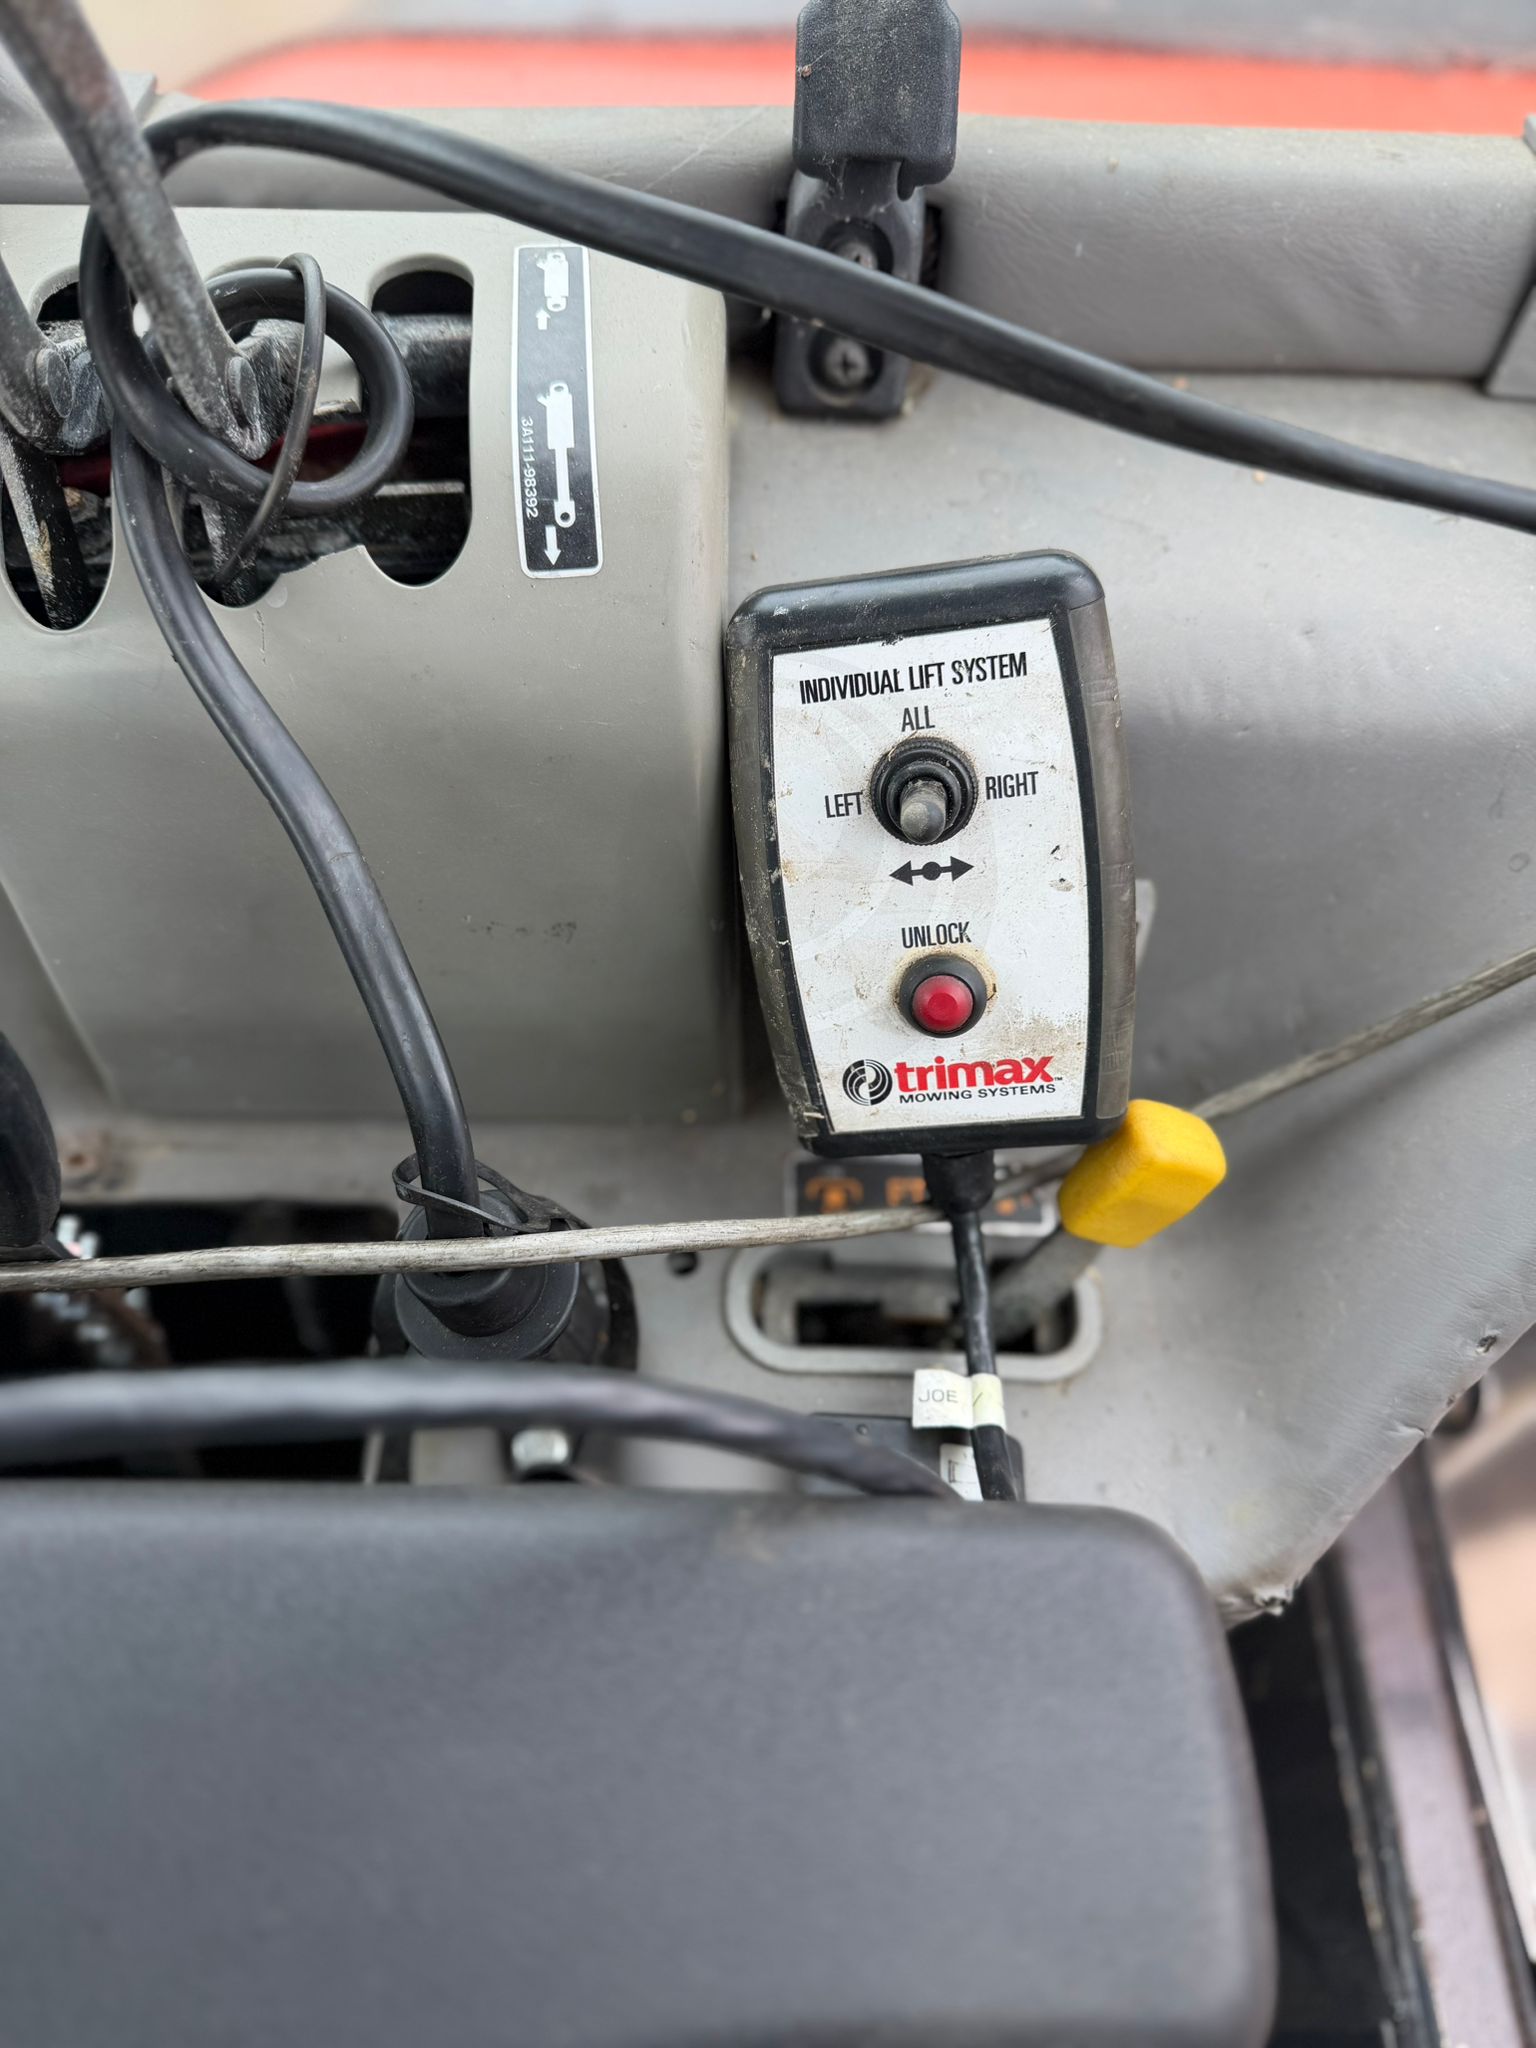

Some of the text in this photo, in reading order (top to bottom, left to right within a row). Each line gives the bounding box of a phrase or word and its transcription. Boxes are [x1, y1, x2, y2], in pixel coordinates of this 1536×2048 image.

[522, 416, 539, 519] 3A111-98392
[799, 651, 1028, 704] INDIVIDUAL LIFT SYSTEM
[901, 705, 935, 732] ALL
[984, 771, 1039, 800] RIGHT
[824, 792, 863, 818] LEFT
[901, 921, 972, 949] UNLOCK
[894, 1055, 1054, 1093] trimax
[899, 1083, 1056, 1104] MOWING SYSTEMS
[919, 1389, 958, 1403] JOE
